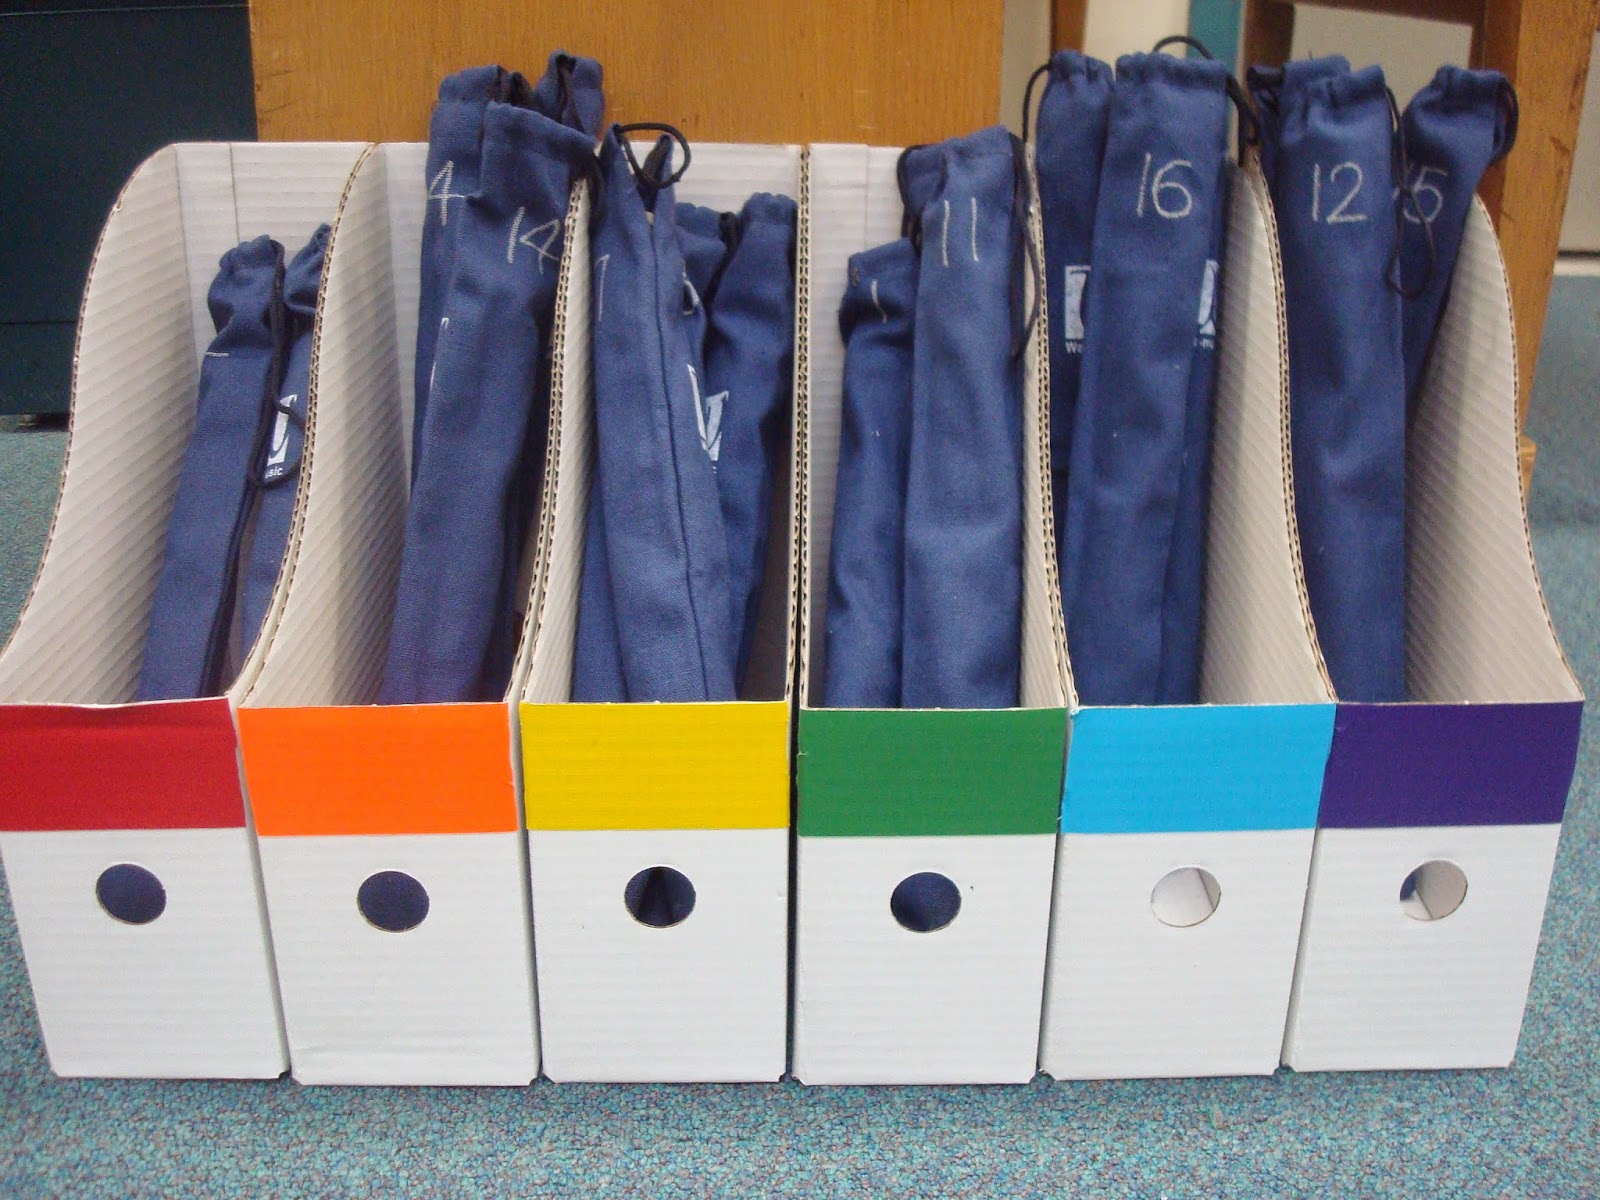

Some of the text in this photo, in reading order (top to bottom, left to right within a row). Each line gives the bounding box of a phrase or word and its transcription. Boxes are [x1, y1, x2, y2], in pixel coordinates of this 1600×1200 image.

[429, 160, 465, 226] 4
[1136, 152, 1192, 219] 16
[1312, 162, 1368, 225] 12
[507, 206, 560, 275] 14
[941, 197, 979, 268] 11
